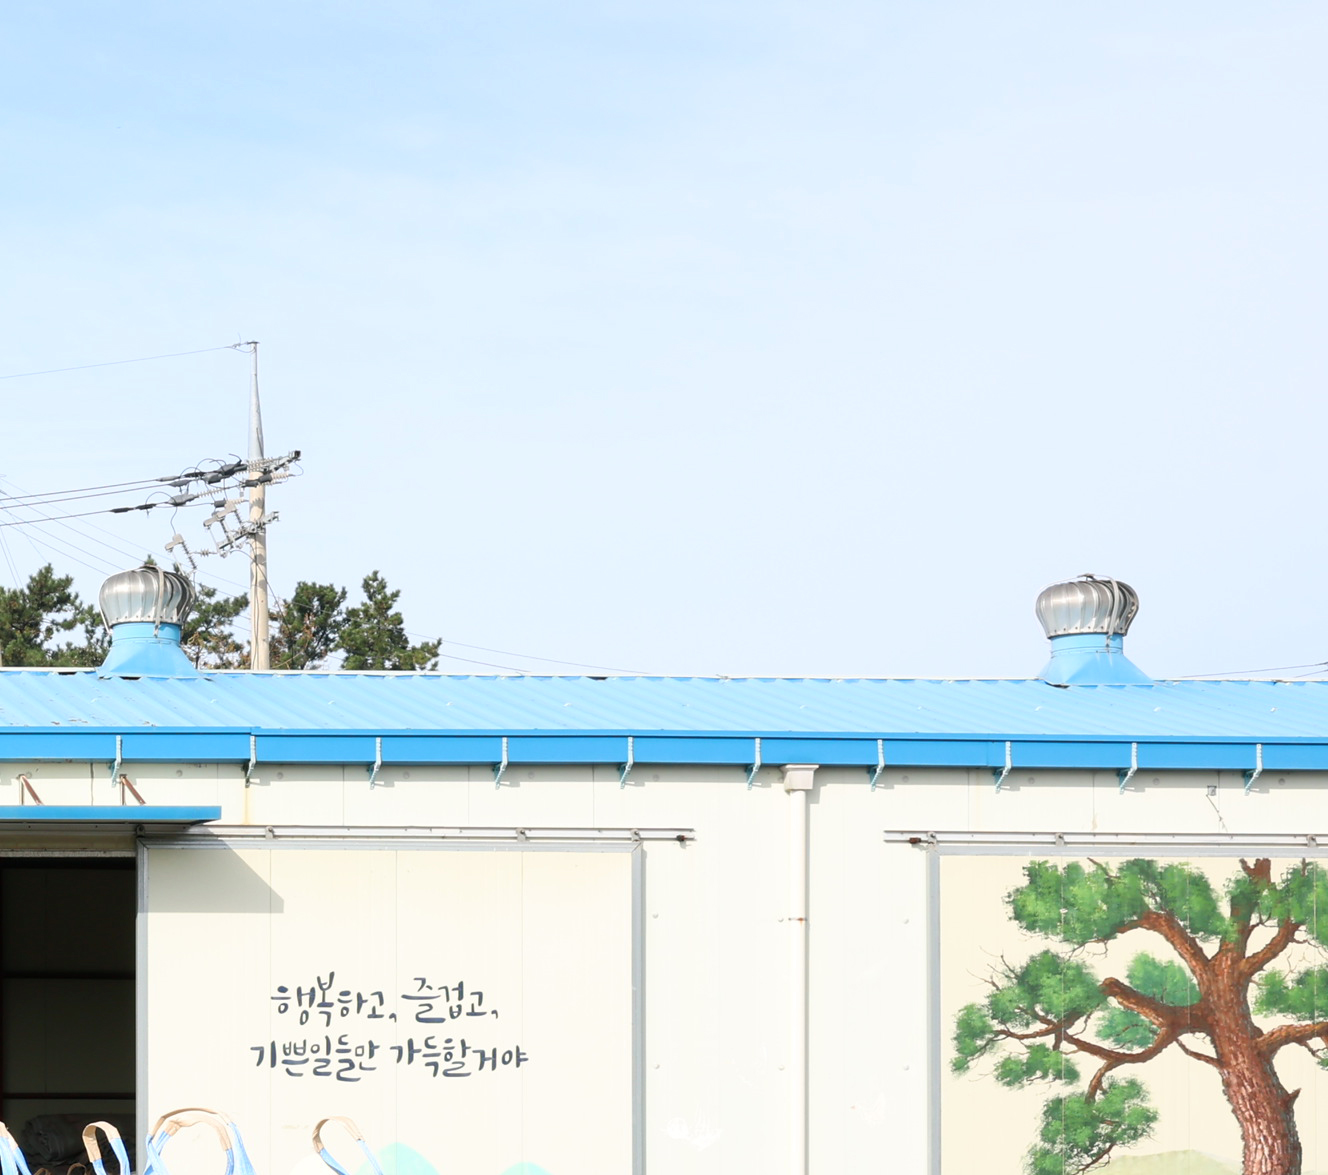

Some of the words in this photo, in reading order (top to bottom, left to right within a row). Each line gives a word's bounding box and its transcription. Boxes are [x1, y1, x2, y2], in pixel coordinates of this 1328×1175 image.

[270, 971, 398, 1027] 행복하고,
[401, 977, 499, 1024] 즐겁고,
[250, 1033, 380, 1083] 기쁜일들만
[390, 1035, 529, 1078] 가득할거야
